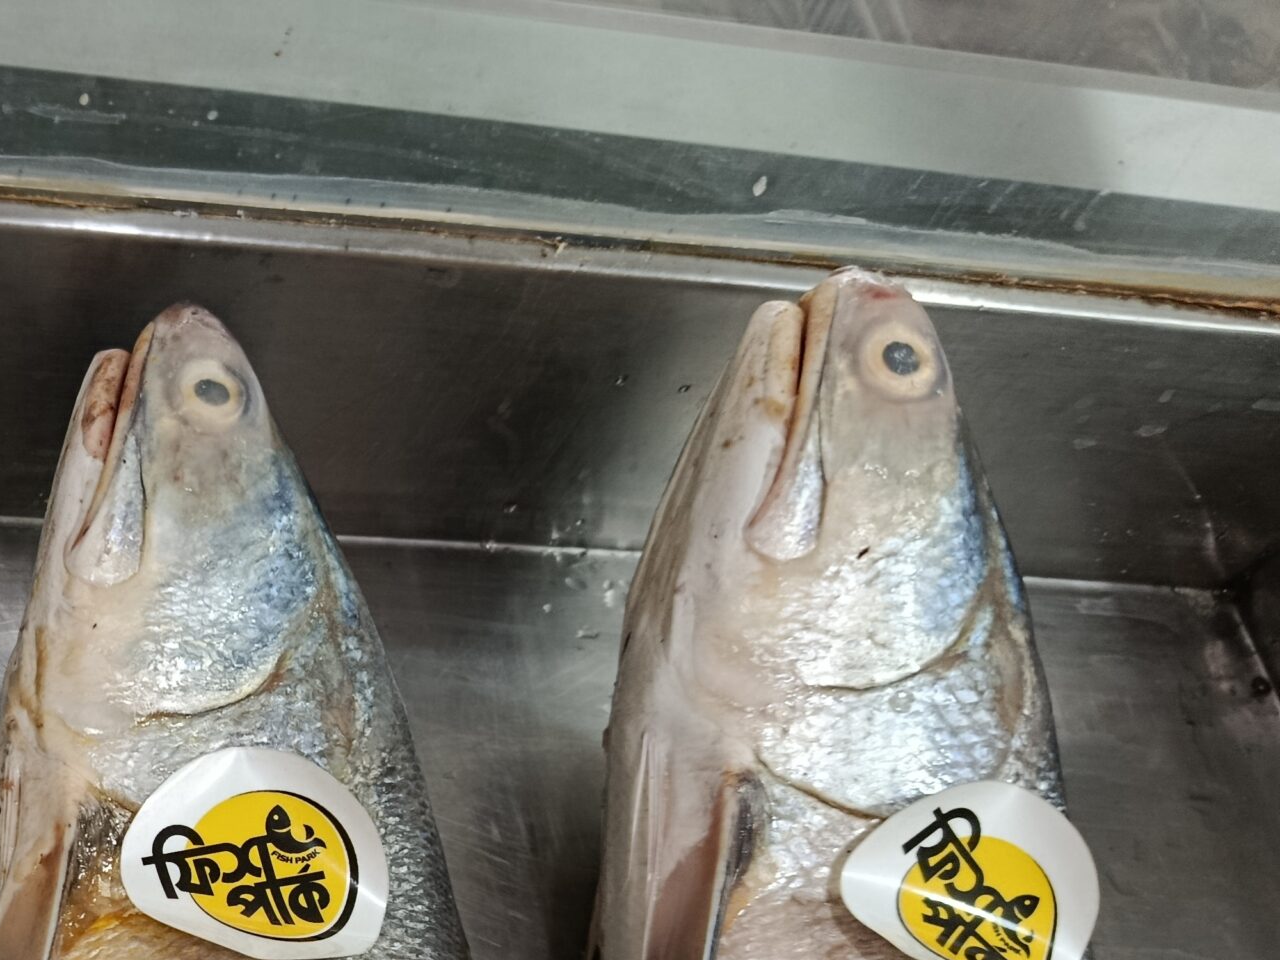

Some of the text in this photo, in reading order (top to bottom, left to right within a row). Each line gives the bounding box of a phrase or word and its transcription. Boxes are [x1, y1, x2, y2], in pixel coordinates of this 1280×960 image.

[271, 849, 321, 864] FISH PARK
[226, 864, 330, 925] পার্ক
